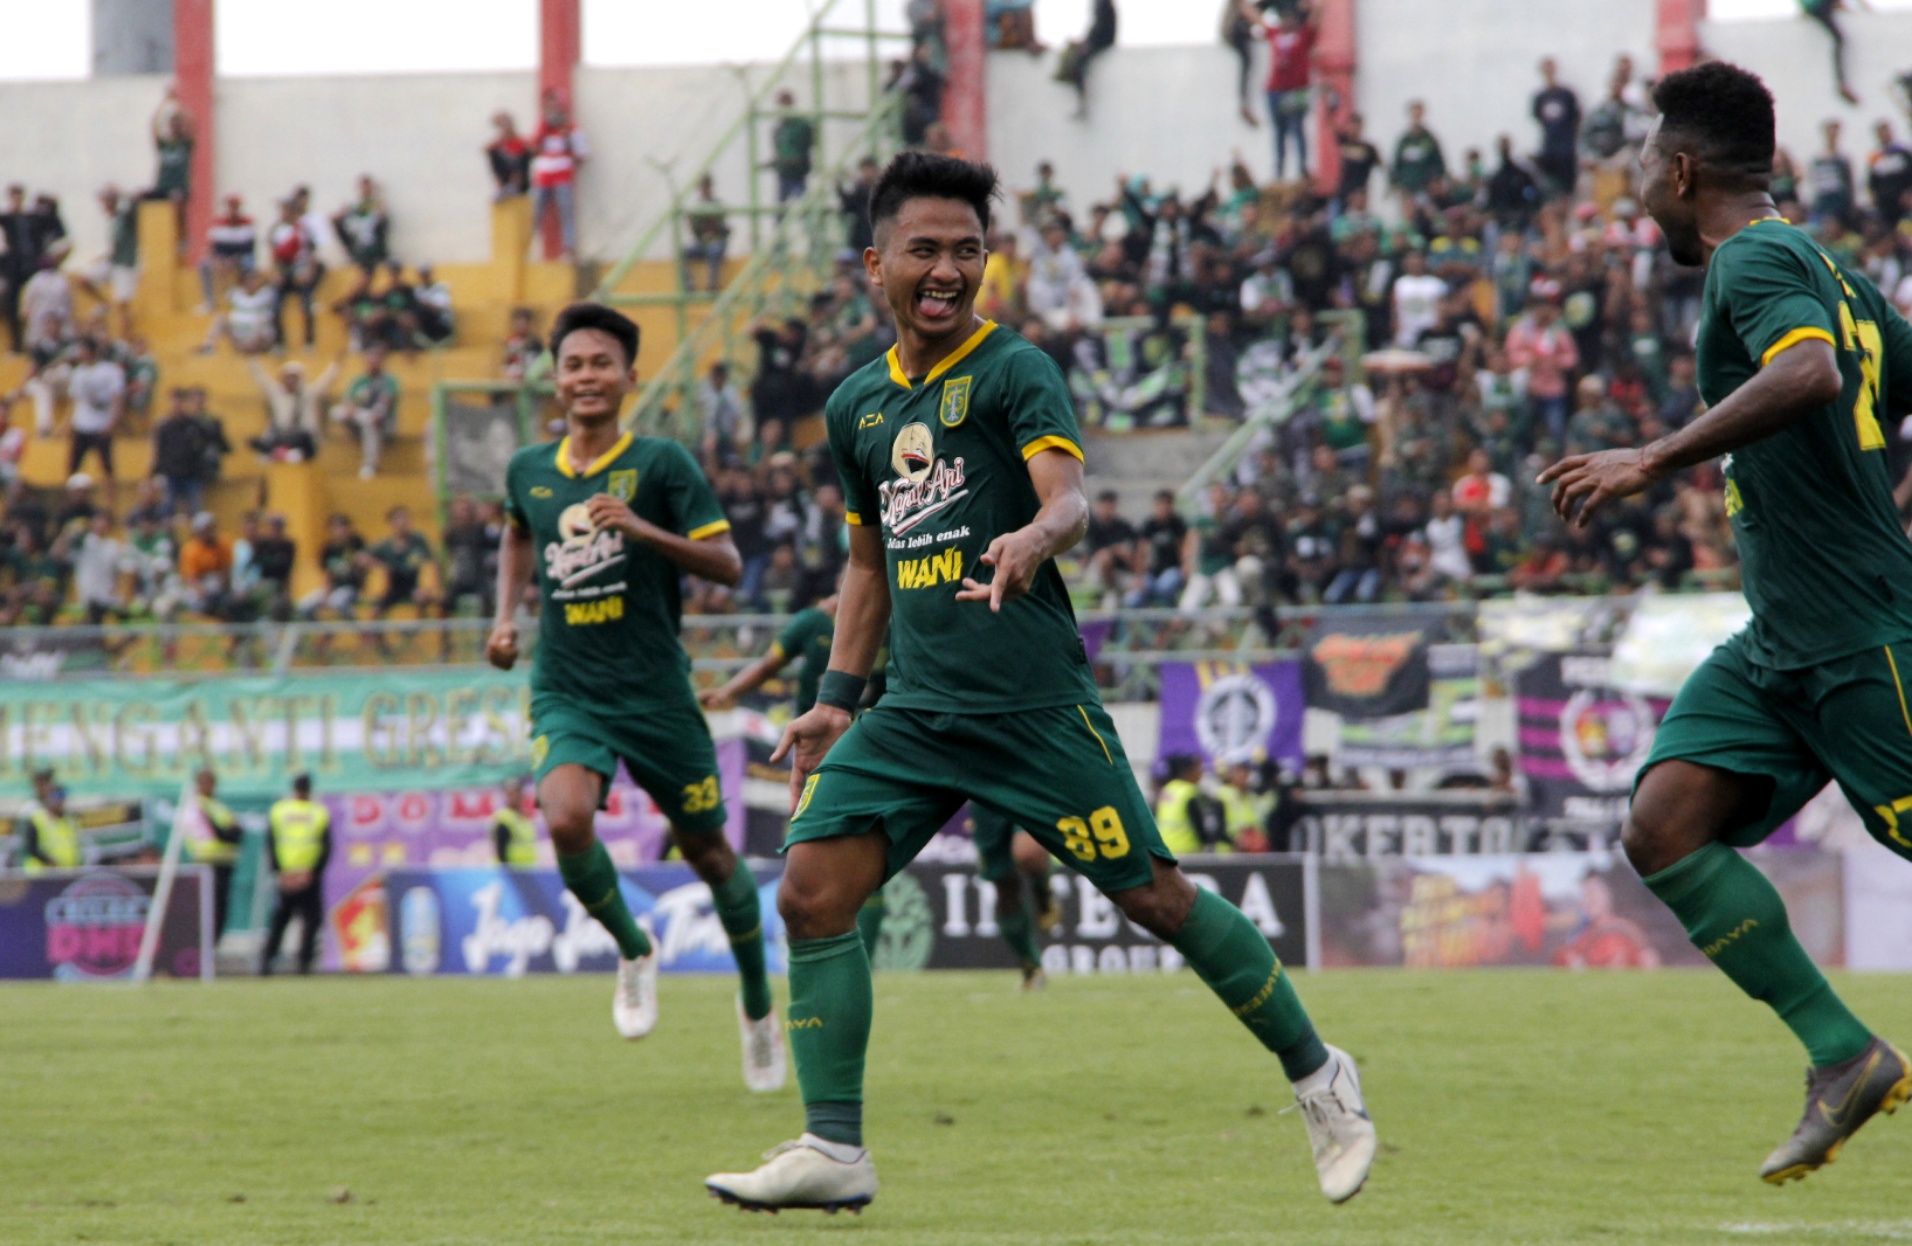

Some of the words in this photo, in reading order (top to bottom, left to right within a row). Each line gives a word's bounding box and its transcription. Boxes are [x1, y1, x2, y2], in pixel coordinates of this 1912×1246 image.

[907, 533, 933, 549] lebih
[936, 525, 970, 542] enak
[897, 545, 963, 589] WANI
[683, 775, 718, 812] 33
[1056, 805, 1131, 862] 89
